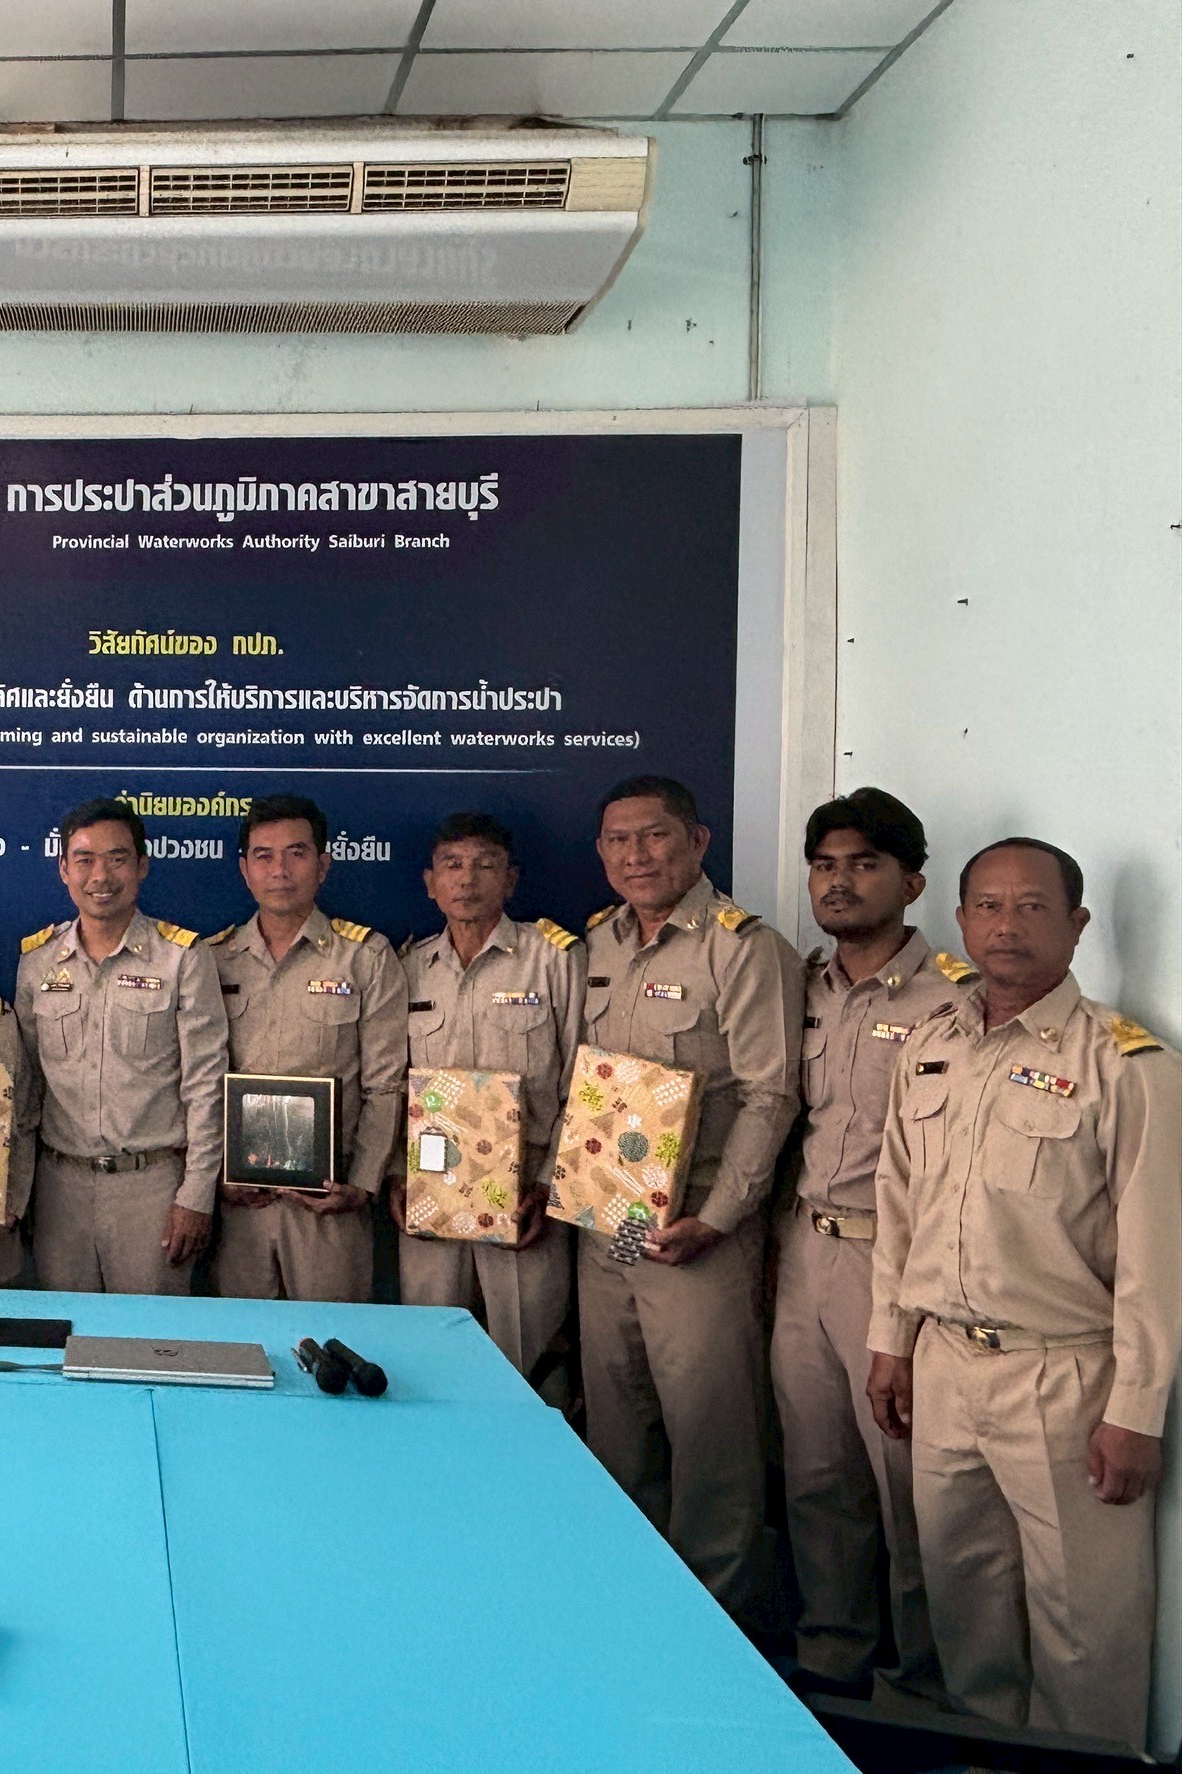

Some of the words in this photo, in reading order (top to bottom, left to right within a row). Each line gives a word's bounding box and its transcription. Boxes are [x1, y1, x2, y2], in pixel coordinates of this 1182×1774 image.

[8, 473, 500, 524] การประปาส่วนภูมิภาคสาขาสายบุรี
[53, 534, 130, 550] Provincial
[138, 534, 235, 550] Waterworks
[243, 534, 322, 555] Authority
[329, 534, 386, 550] Saiburi
[395, 534, 451, 550] Branch
[89, 630, 219, 656] วิสัยทัศน์ของ
[233, 632, 285, 656] กปภ.
[128, 679, 563, 712] ด้านการให้บริการและบริหารจัดการน้ำประปา
[52, 728, 84, 744] and
[92, 728, 189, 745] sustainable
[197, 729, 306, 749] organization
[315, 730, 355, 746] with
[363, 730, 443, 747] excellent
[451, 731, 556, 747] waterworks
[565, 731, 641, 750] services)
[326, 831, 391, 862] ยั่งยืน
